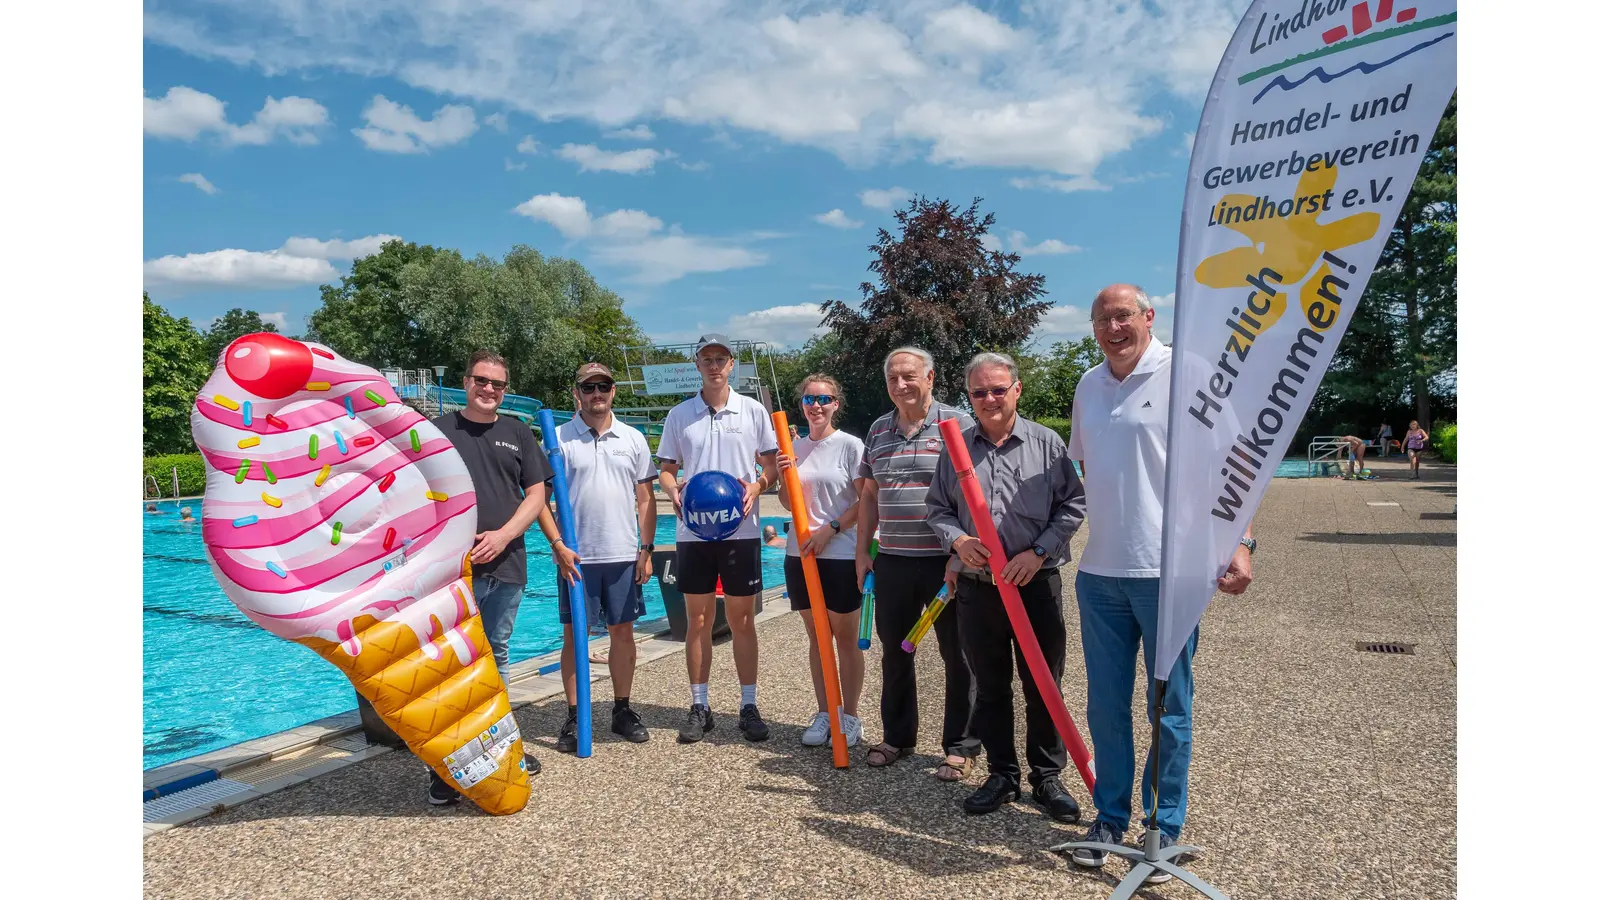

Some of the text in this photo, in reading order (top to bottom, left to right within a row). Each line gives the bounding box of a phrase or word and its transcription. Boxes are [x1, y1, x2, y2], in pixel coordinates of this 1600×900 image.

[1230, 83, 1413, 146] Handel- und
[1203, 129, 1420, 190] Gewerbeverein
[1207, 176, 1394, 227] Lindhorst e.V.
[1188, 267, 1284, 430] Herzlich
[1211, 250, 1357, 523] willkommen!
[687, 506, 741, 526] NIVEA
[662, 560, 676, 584] 4
